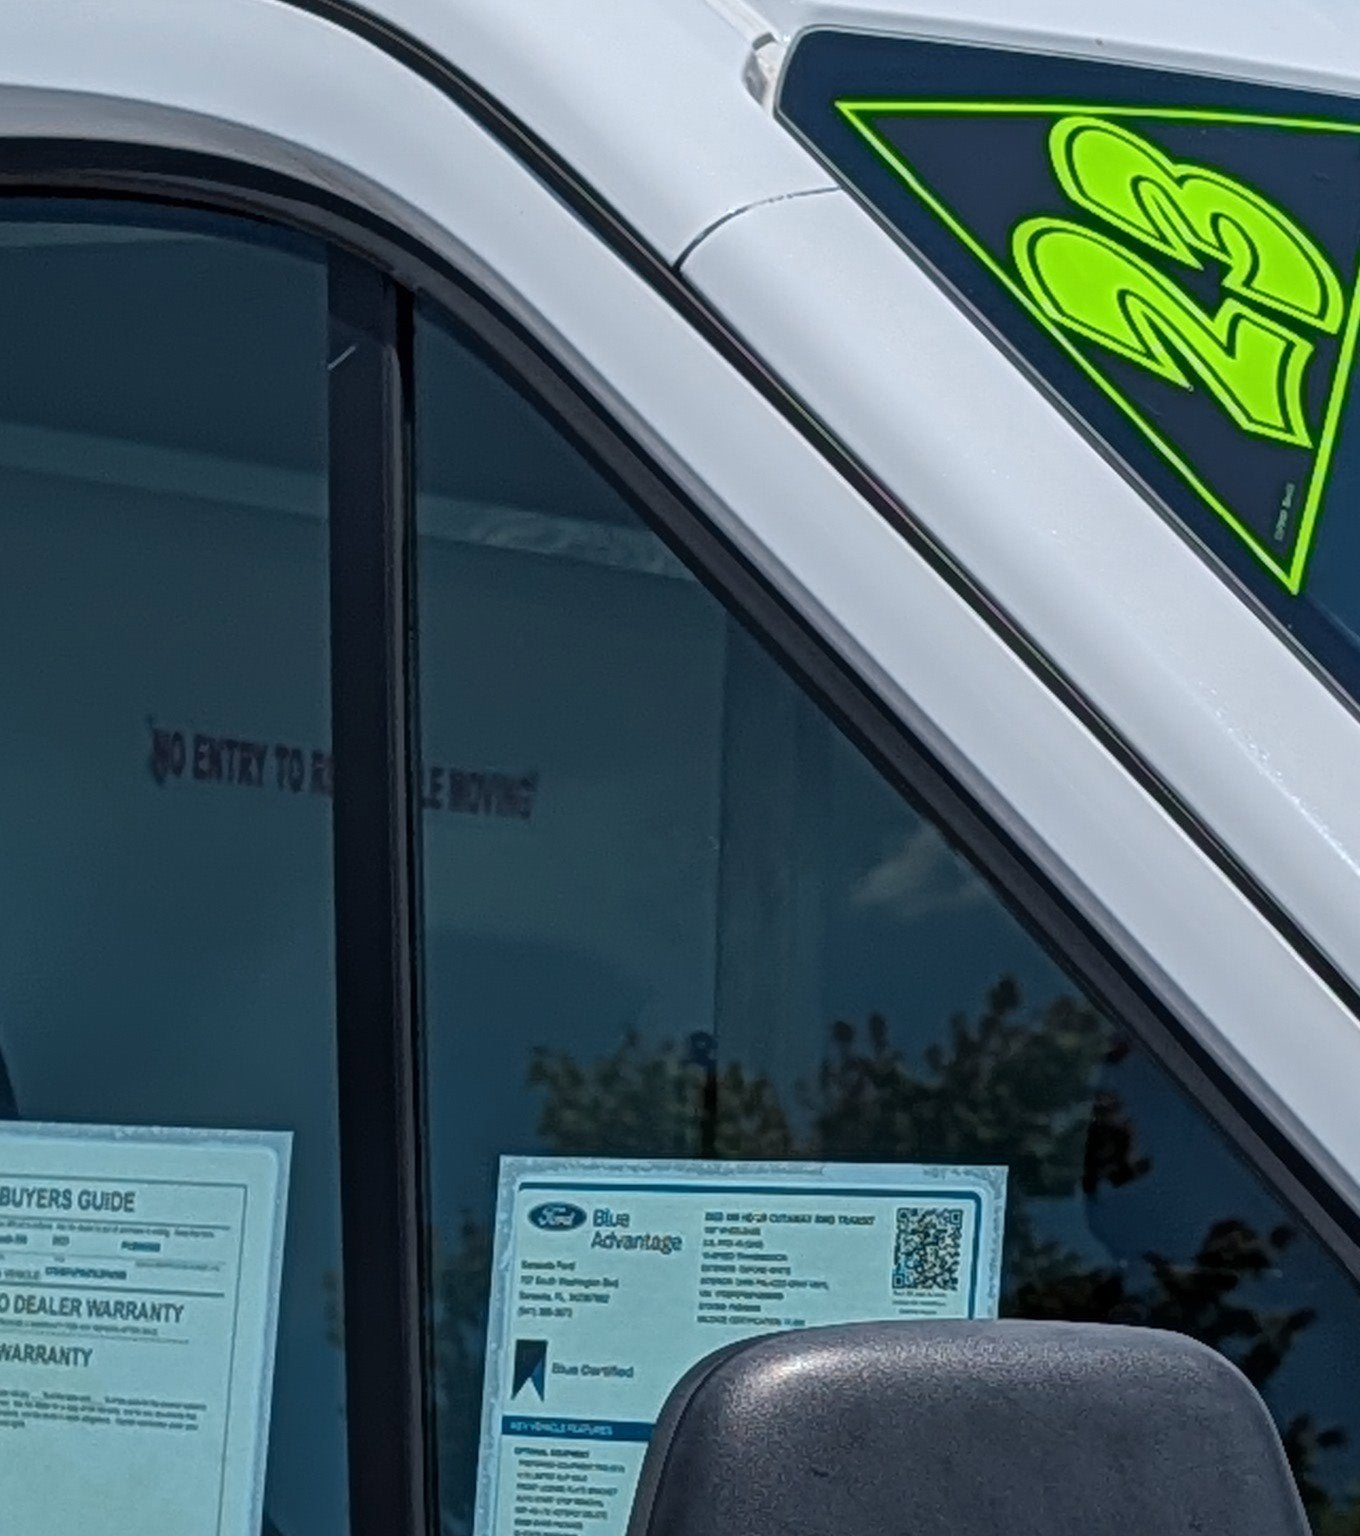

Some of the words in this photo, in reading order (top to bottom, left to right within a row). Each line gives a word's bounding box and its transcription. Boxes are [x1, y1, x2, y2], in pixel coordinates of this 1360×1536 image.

[1012, 116, 1344, 449] 23
[193, 734, 268, 788] ENTRY
[275, 743, 305, 793] TO
[78, 1188, 136, 1213] GUIDE
[592, 1207, 631, 1229] Blue
[590, 1230, 683, 1256] Advantage
[14, 1294, 83, 1318] DEALER
[86, 1298, 185, 1324] WARRANTY
[552, 1361, 579, 1376] Blue
[581, 1363, 634, 1379] Certified
